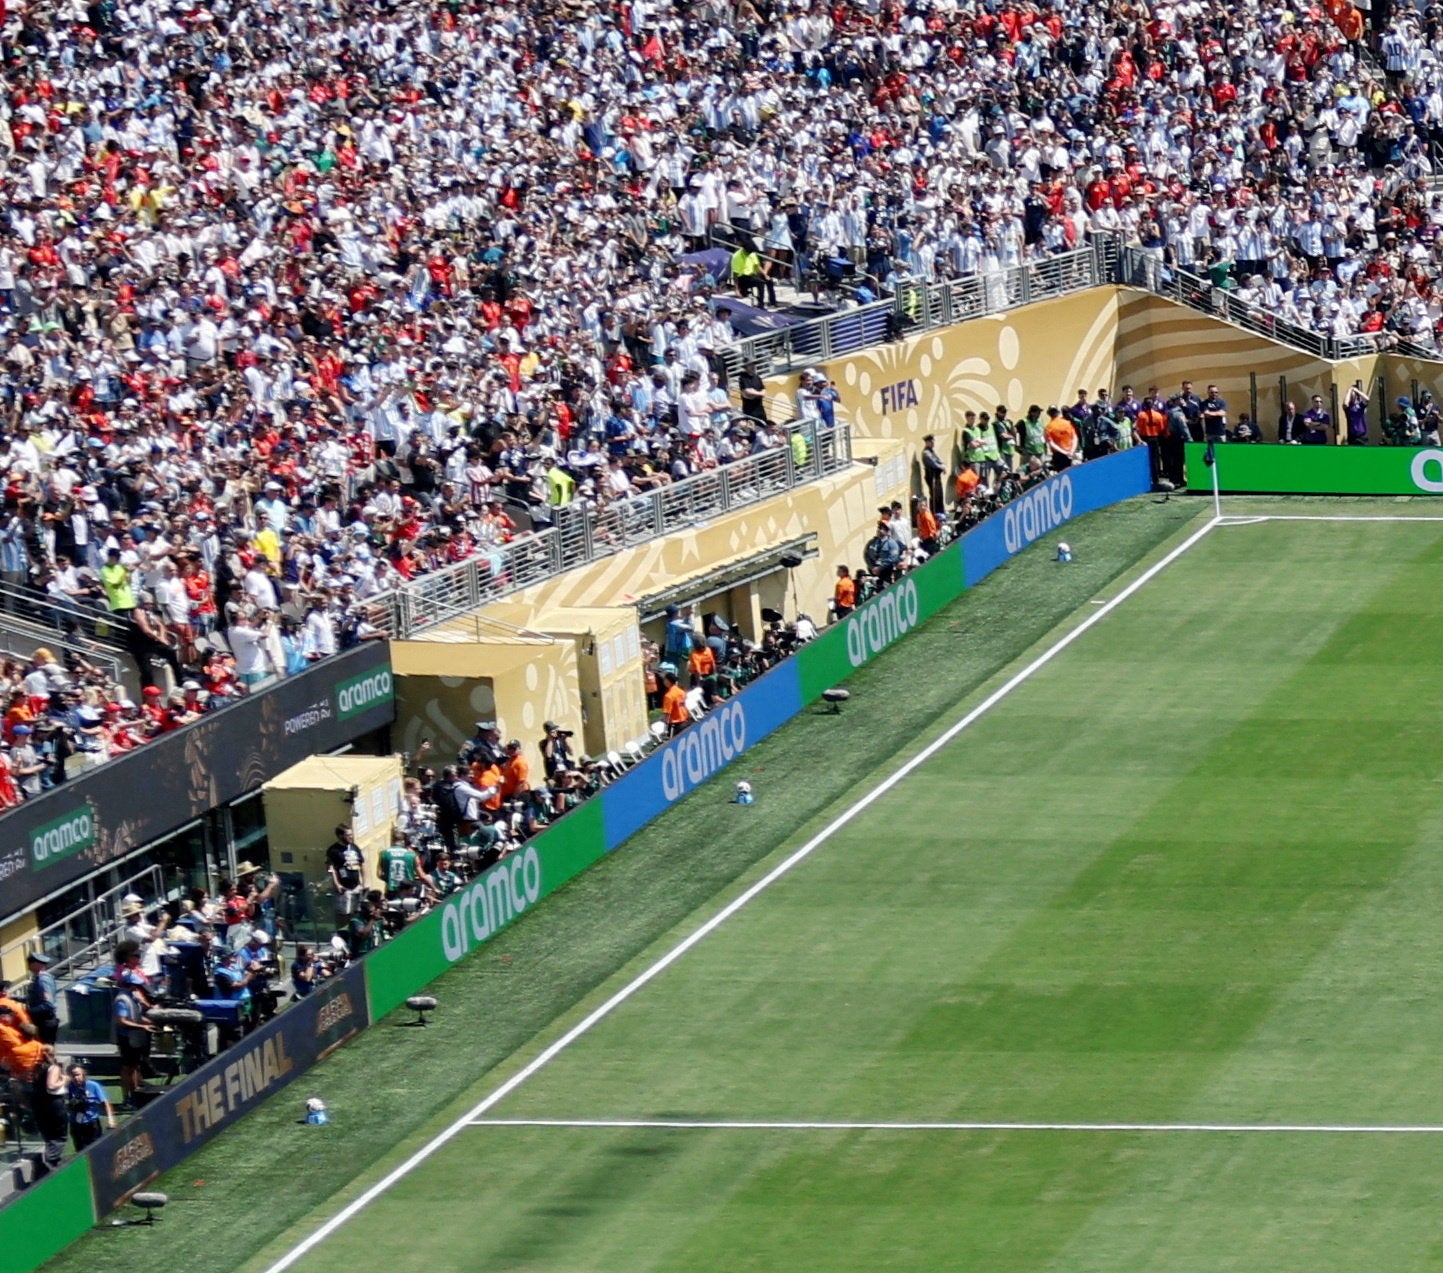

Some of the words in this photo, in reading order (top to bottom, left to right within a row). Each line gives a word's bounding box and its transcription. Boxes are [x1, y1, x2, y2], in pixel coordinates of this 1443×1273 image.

[879, 378, 919, 416] FIFA
[1004, 474, 1073, 554] aramco
[847, 578, 918, 668] aramco
[339, 671, 391, 712] aramco
[661, 700, 746, 801] aramco
[33, 814, 90, 861] aramco
[441, 846, 540, 962] aramco
[175, 1073, 225, 1144] THE
[224, 1030, 294, 1112] FINAL
